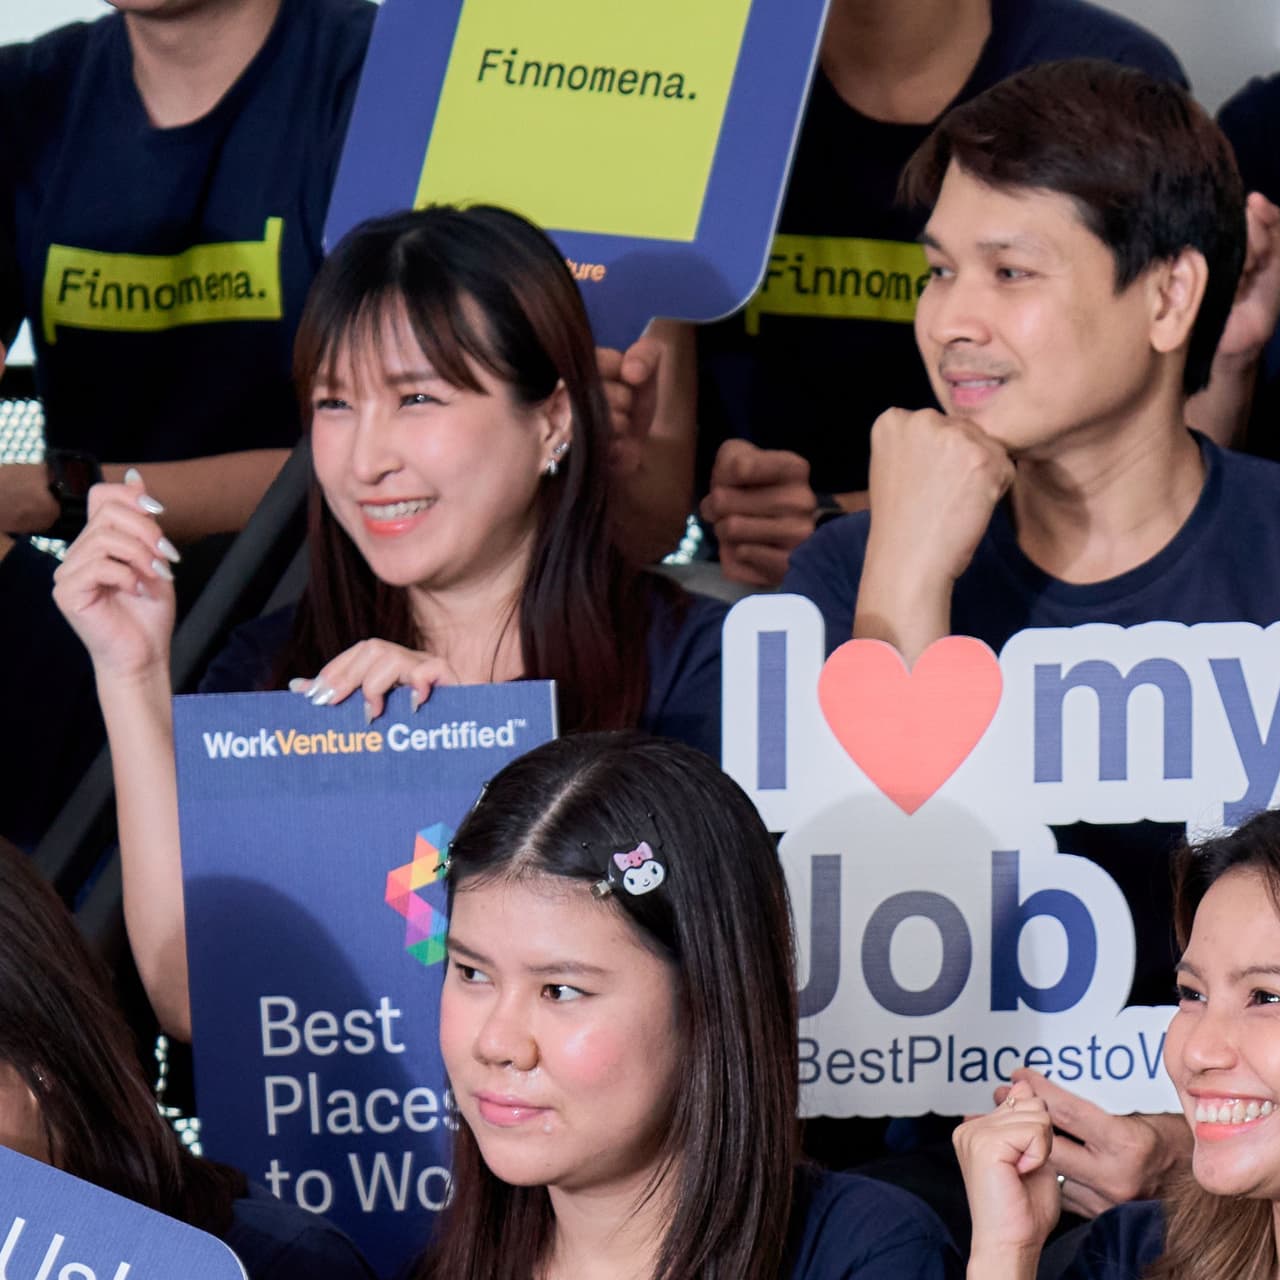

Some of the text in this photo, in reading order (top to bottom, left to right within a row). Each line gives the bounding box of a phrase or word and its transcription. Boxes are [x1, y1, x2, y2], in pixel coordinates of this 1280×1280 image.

[477, 48, 697, 100] Finnomena.
[57, 266, 267, 310] Finnomena.
[757, 630, 787, 789] I
[203, 728, 383, 759] WorkVenture
[798, 849, 1099, 1019] Job
[259, 995, 406, 1057] Best
[264, 1159, 333, 1215] to
